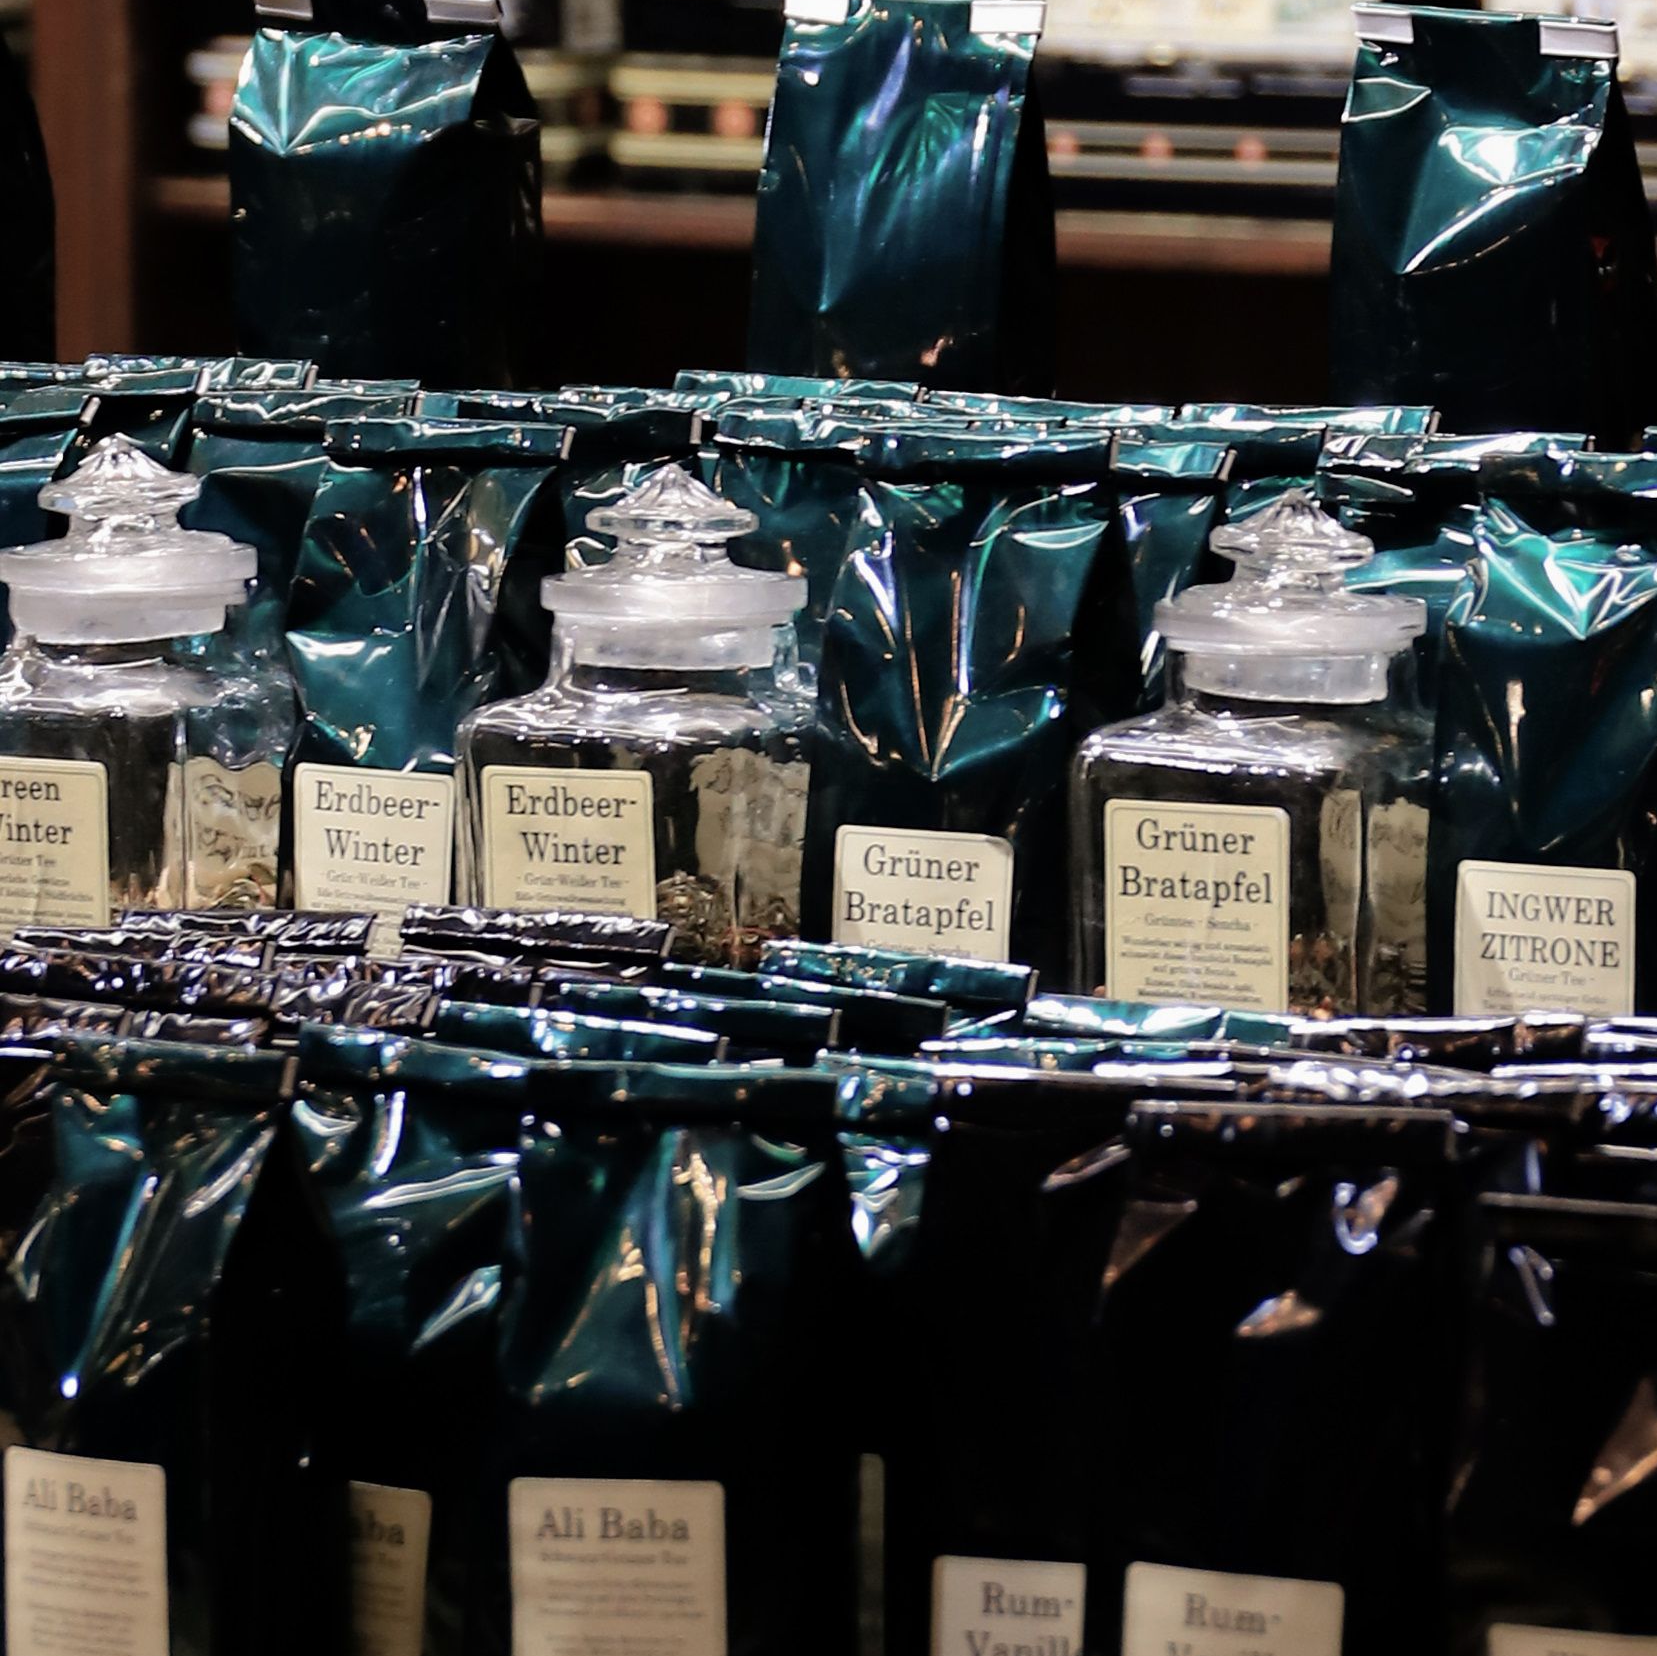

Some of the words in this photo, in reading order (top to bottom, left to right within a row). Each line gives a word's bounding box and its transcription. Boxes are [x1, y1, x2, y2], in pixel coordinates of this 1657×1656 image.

[0, 779, 62, 802] reen
[313, 779, 441, 820] Erdbeer-
[504, 783, 638, 819] Erdbeer-
[323, 827, 426, 867] Winter
[519, 830, 627, 866] Winter
[1135, 817, 1256, 856] Grüner
[863, 843, 981, 883] Grüner
[1118, 864, 1273, 909] Bratapfel
[843, 889, 996, 936] Bratapfel
[1486, 890, 1617, 927] INGWER
[1480, 931, 1621, 969] ZITRONE
[21, 1476, 59, 1511] Ali
[65, 1480, 139, 1522] Baba
[536, 1505, 587, 1541] Ali
[597, 1506, 691, 1544] Baba
[980, 1579, 1075, 1619] Rum-
